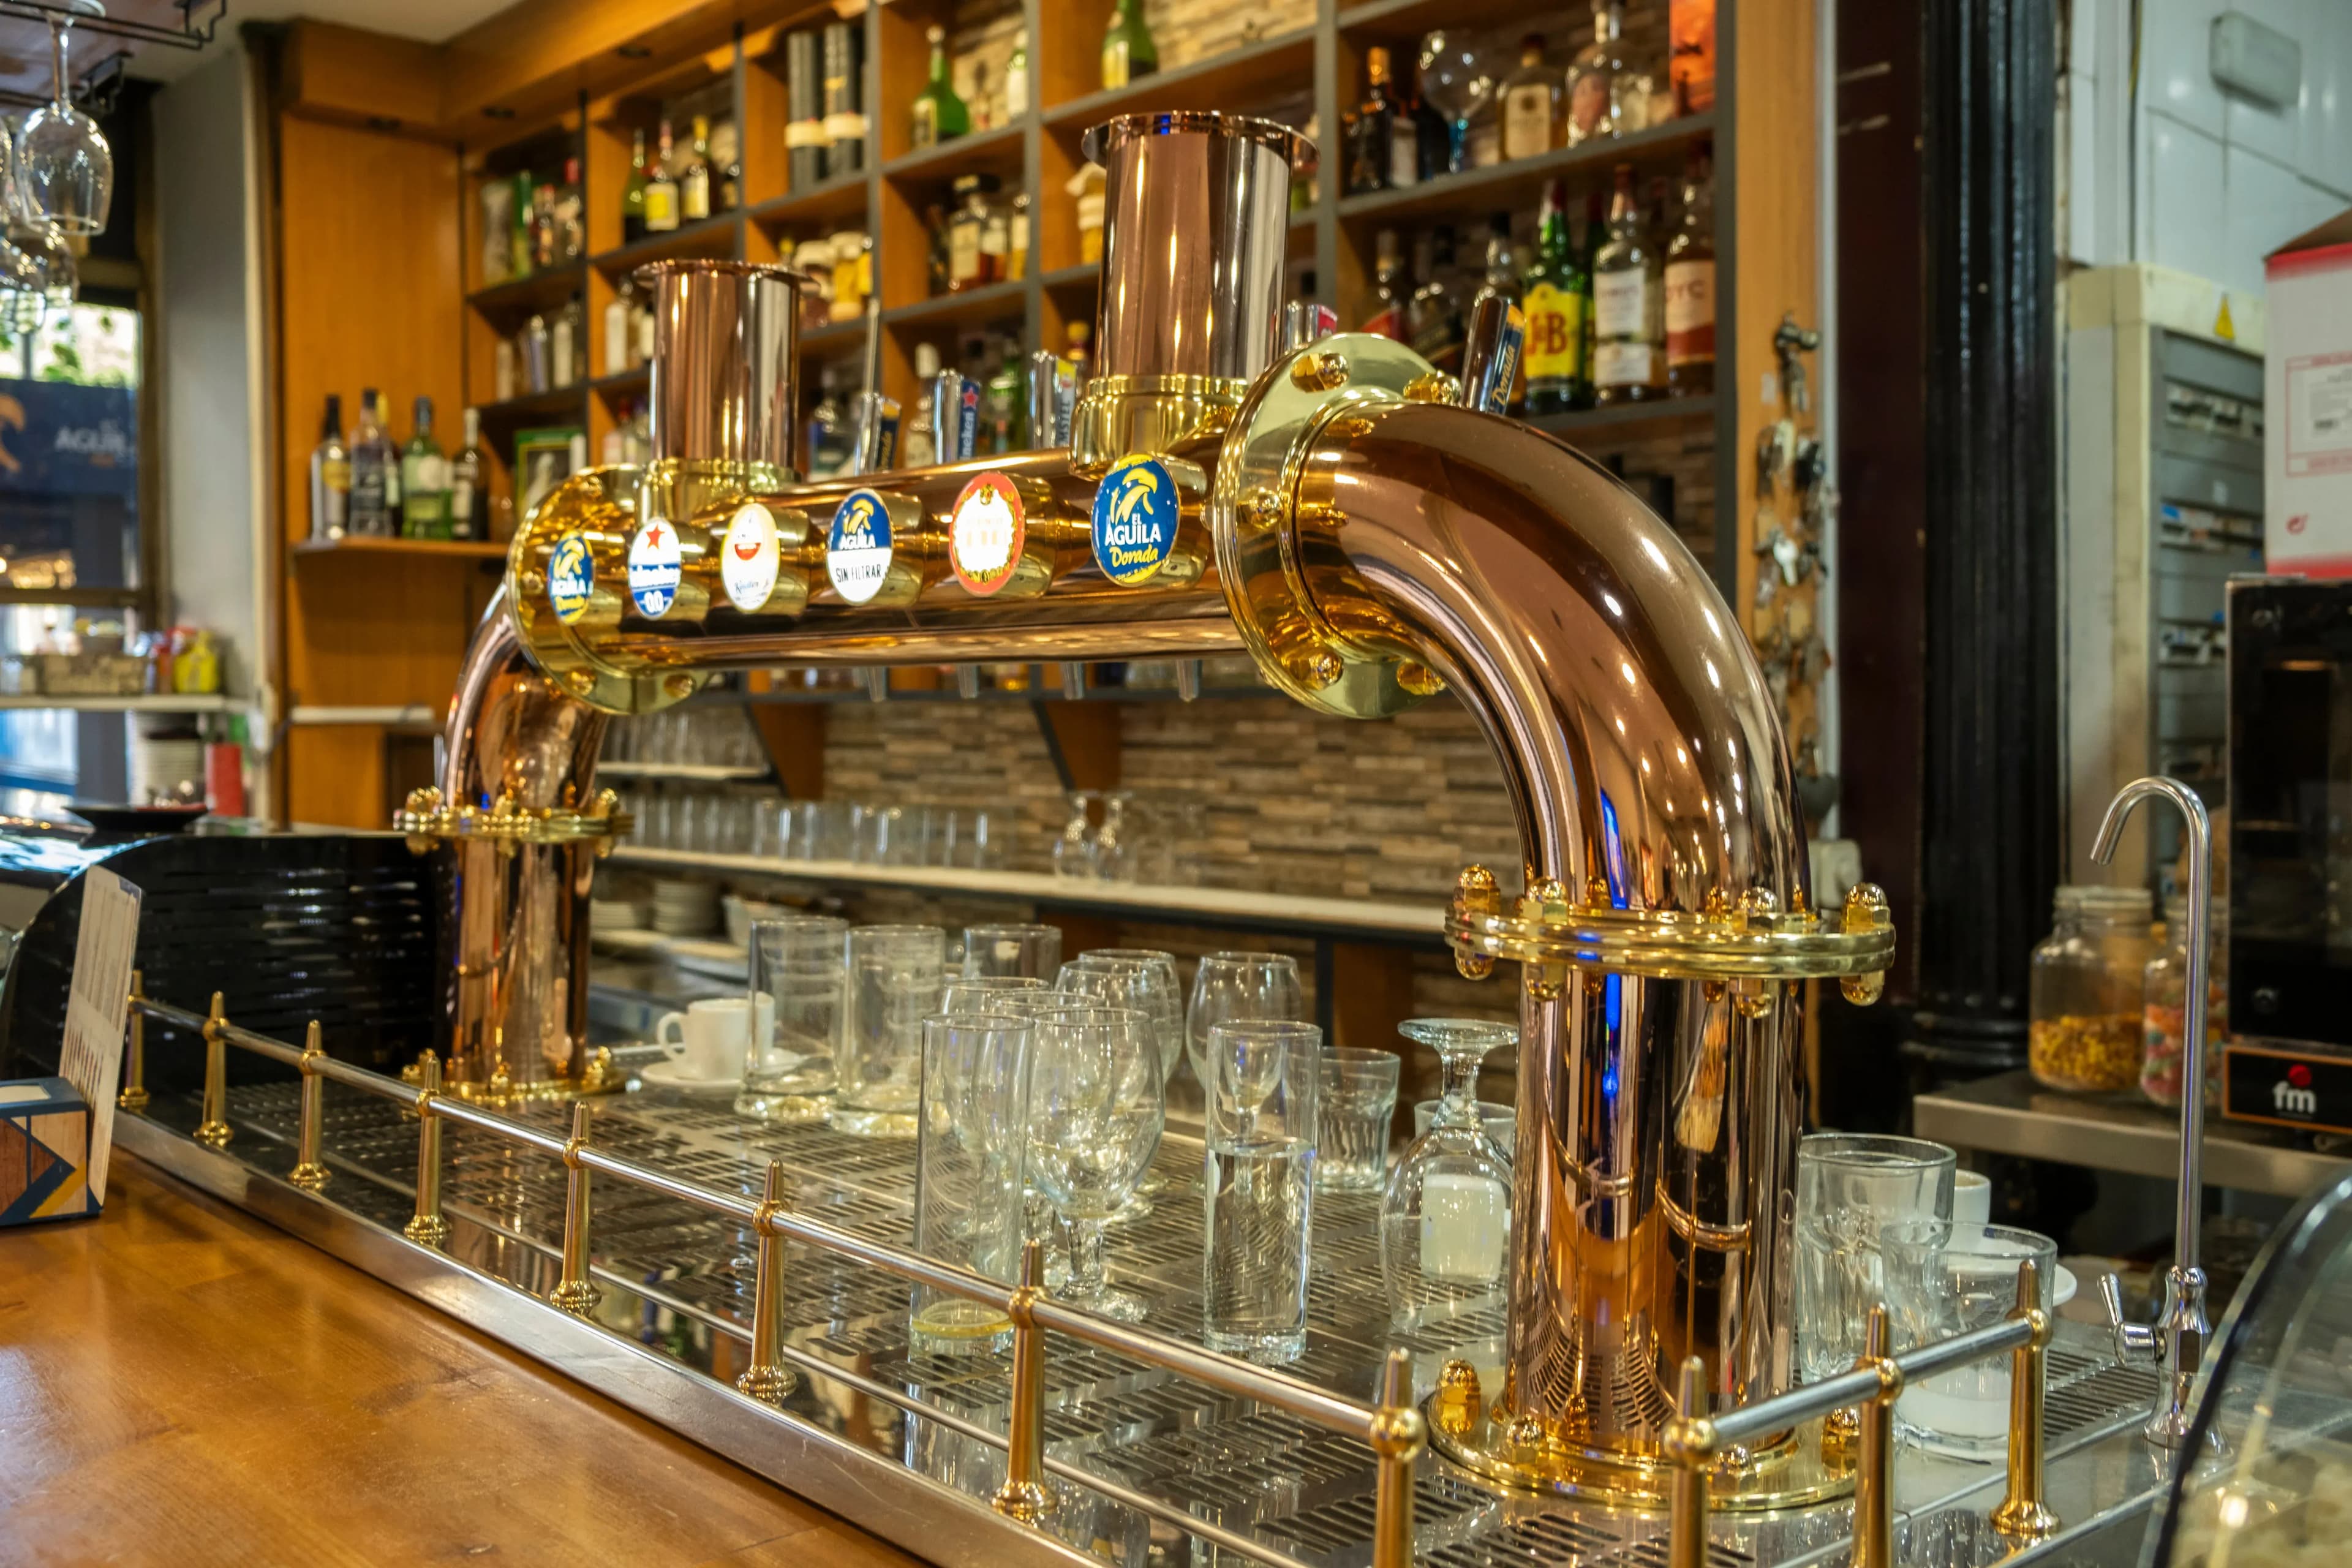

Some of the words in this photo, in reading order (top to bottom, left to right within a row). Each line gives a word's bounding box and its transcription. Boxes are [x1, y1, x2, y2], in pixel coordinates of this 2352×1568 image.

[1491, 344, 1516, 405] Dorada
[1058, 401, 1071, 446] MSTEL
[1131, 513, 1142, 526] EL
[1109, 543, 1159, 567] Dorada
[835, 567, 849, 582] SIN
[851, 564, 881, 581] FILTRAR
[2272, 1080, 2317, 1114] fm
